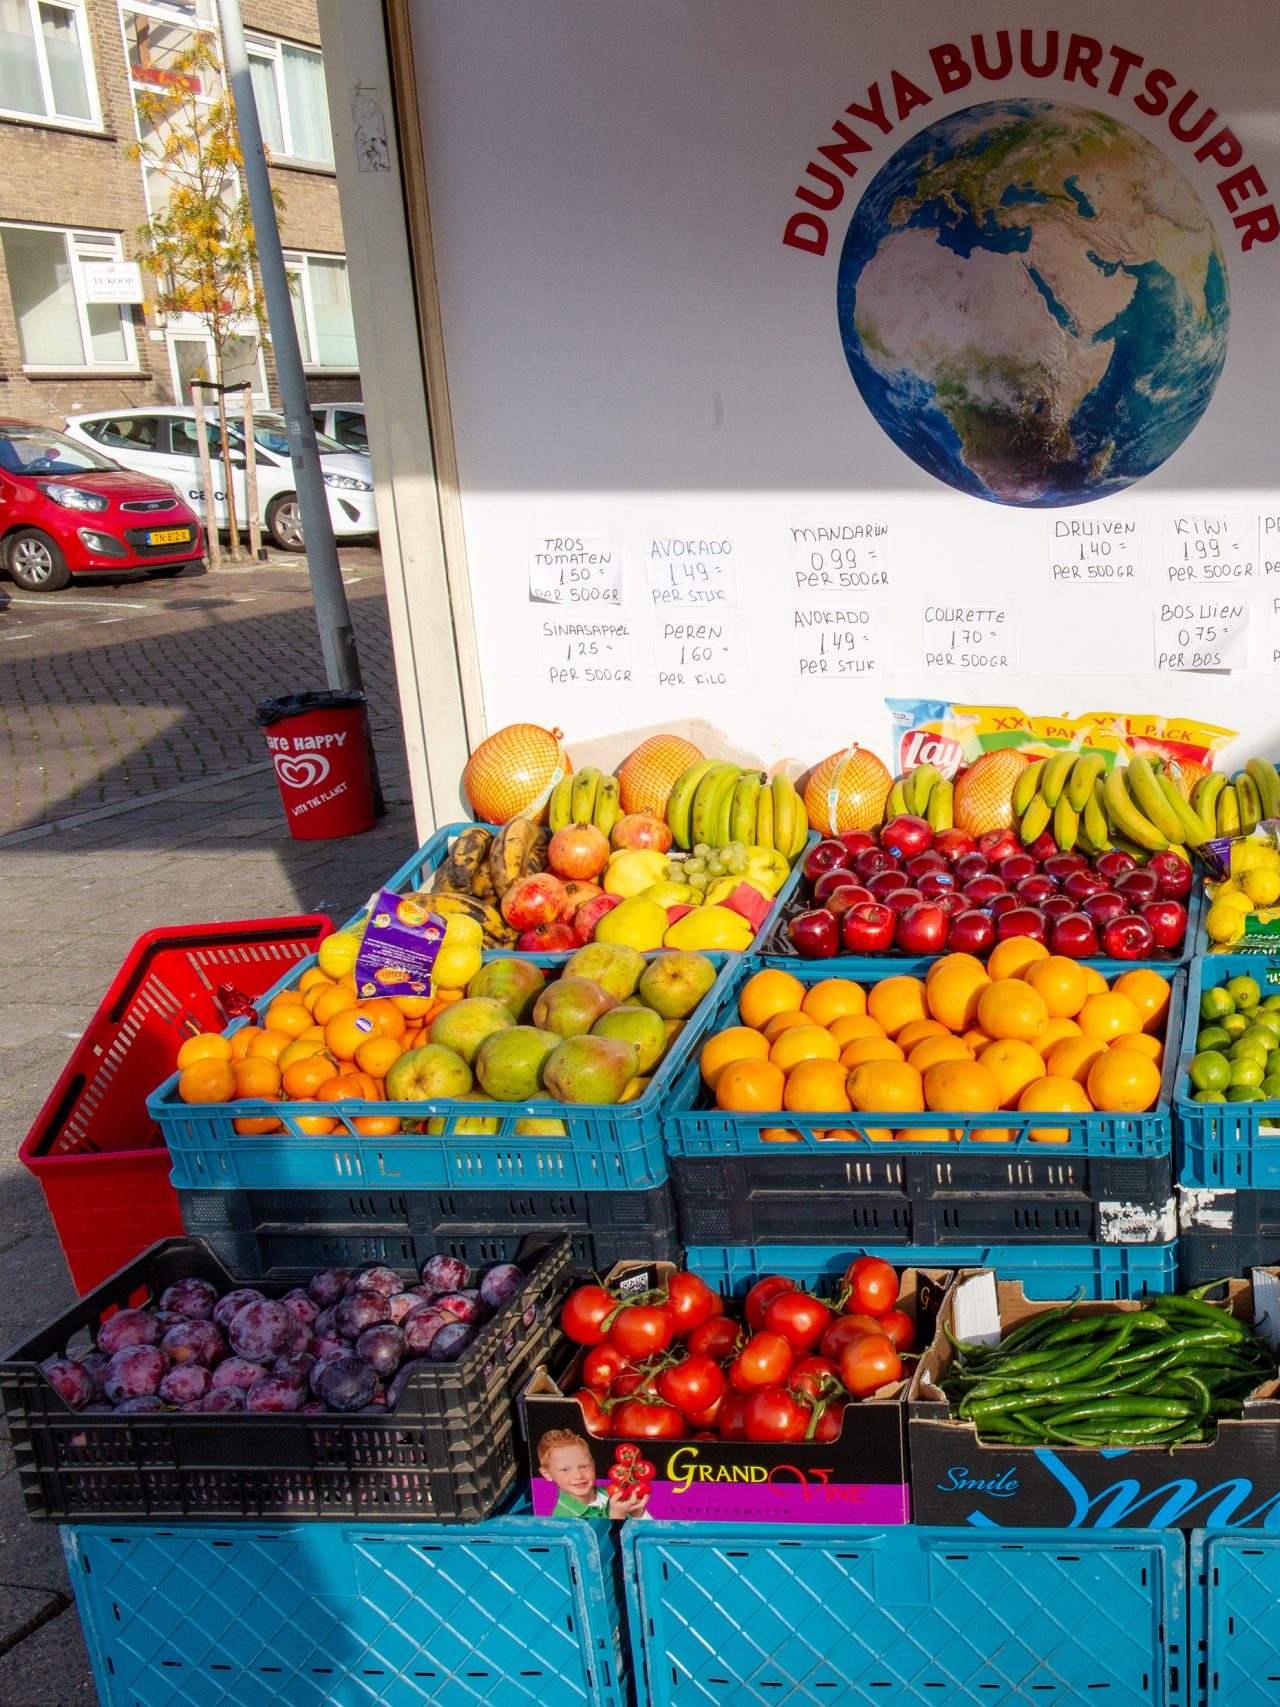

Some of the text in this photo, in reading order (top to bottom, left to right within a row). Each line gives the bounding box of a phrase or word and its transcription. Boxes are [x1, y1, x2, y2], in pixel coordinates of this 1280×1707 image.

[782, 28, 1280, 257] DUNYA BUURTSUPER
[94, 277, 134, 285] TE KOOP
[154, 530, 187, 543] TN-812-X
[544, 539, 584, 551] TROS
[651, 540, 732, 558] AVOKADO
[1080, 541, 1112, 560] 1.40
[1184, 539, 1220, 561] 1.99
[811, 548, 857, 571] 0.99
[559, 569, 591, 586] 1.50
[670, 563, 709, 586] 1.49
[689, 590, 725, 602] STUK
[795, 611, 869, 627] AVOKADO
[820, 633, 855, 655] 1.49
[950, 630, 982, 649] 1.70
[1179, 627, 1217, 647] 0.75
[568, 644, 598, 660] 1.25
[680, 648, 712, 665] 1.60
[1192, 652, 1221, 665] BOS
[839, 659, 876, 672] STUK
[1145, 725, 1193, 742] PACK
[306, 796, 321, 809] THE
[320, 781, 348, 803] PLANET
[667, 1447, 769, 1494] GRAND
[937, 1466, 1020, 1498] Smile
